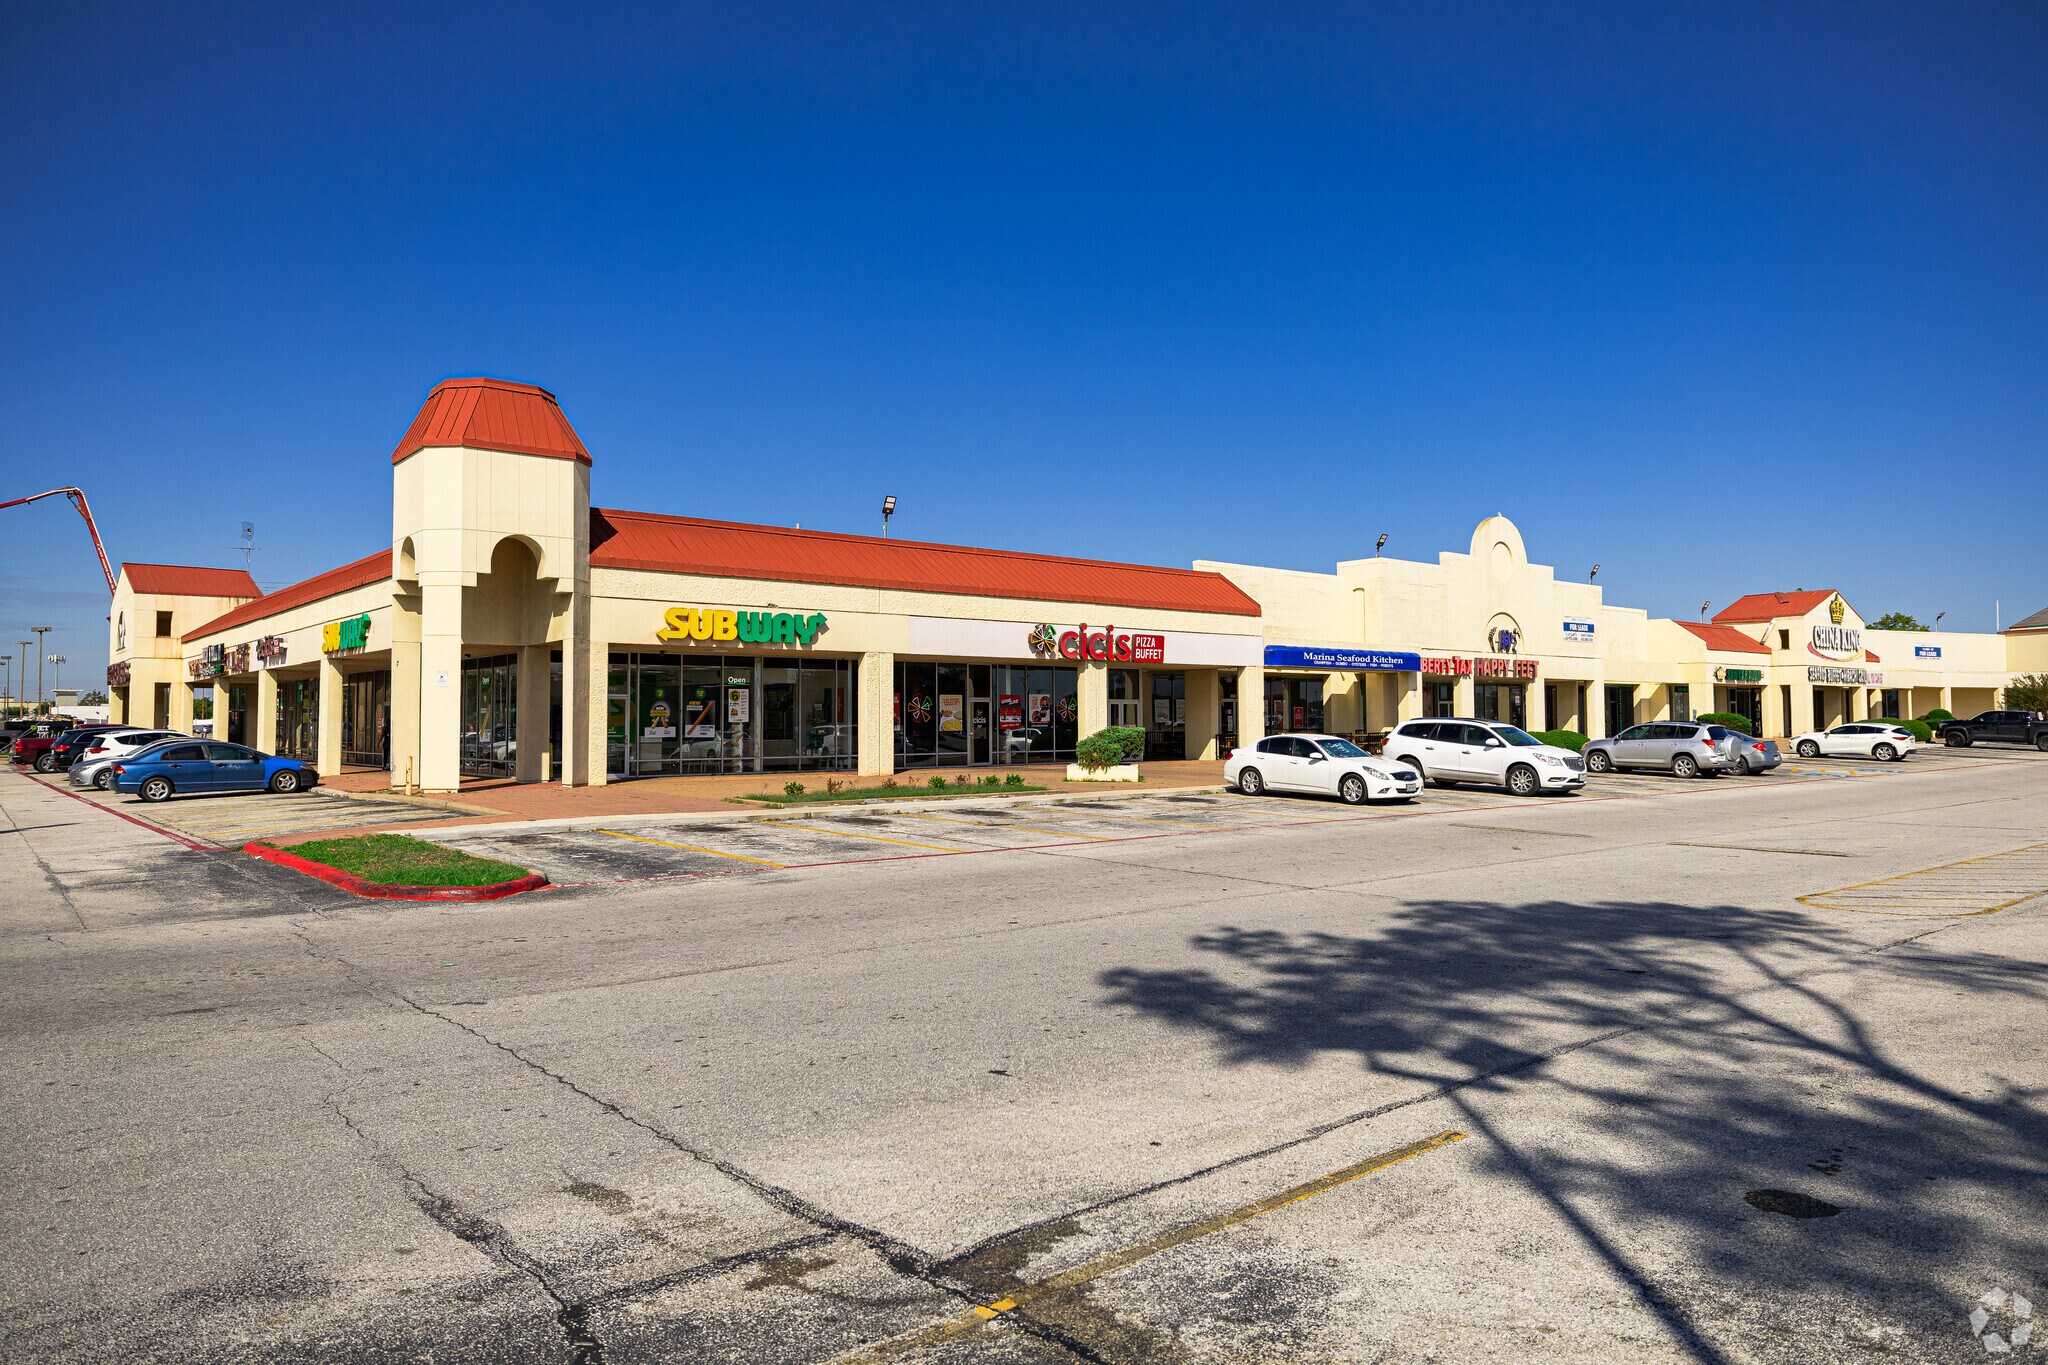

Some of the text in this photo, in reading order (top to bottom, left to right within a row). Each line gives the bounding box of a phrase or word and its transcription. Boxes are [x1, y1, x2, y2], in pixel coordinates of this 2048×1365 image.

[656, 607, 828, 644] SUBWAY
[1060, 622, 1132, 661] cicis
[1135, 636, 1156, 648] PIZZA
[1813, 626, 1860, 652] CHINA KING
[1135, 648, 1163, 660] BUFFET
[1303, 652, 1403, 665] Marina Seafood Kitchen
[1421, 656, 1473, 675] BERTY TAX
[1475, 658, 1540, 679] HAPPY FEET
